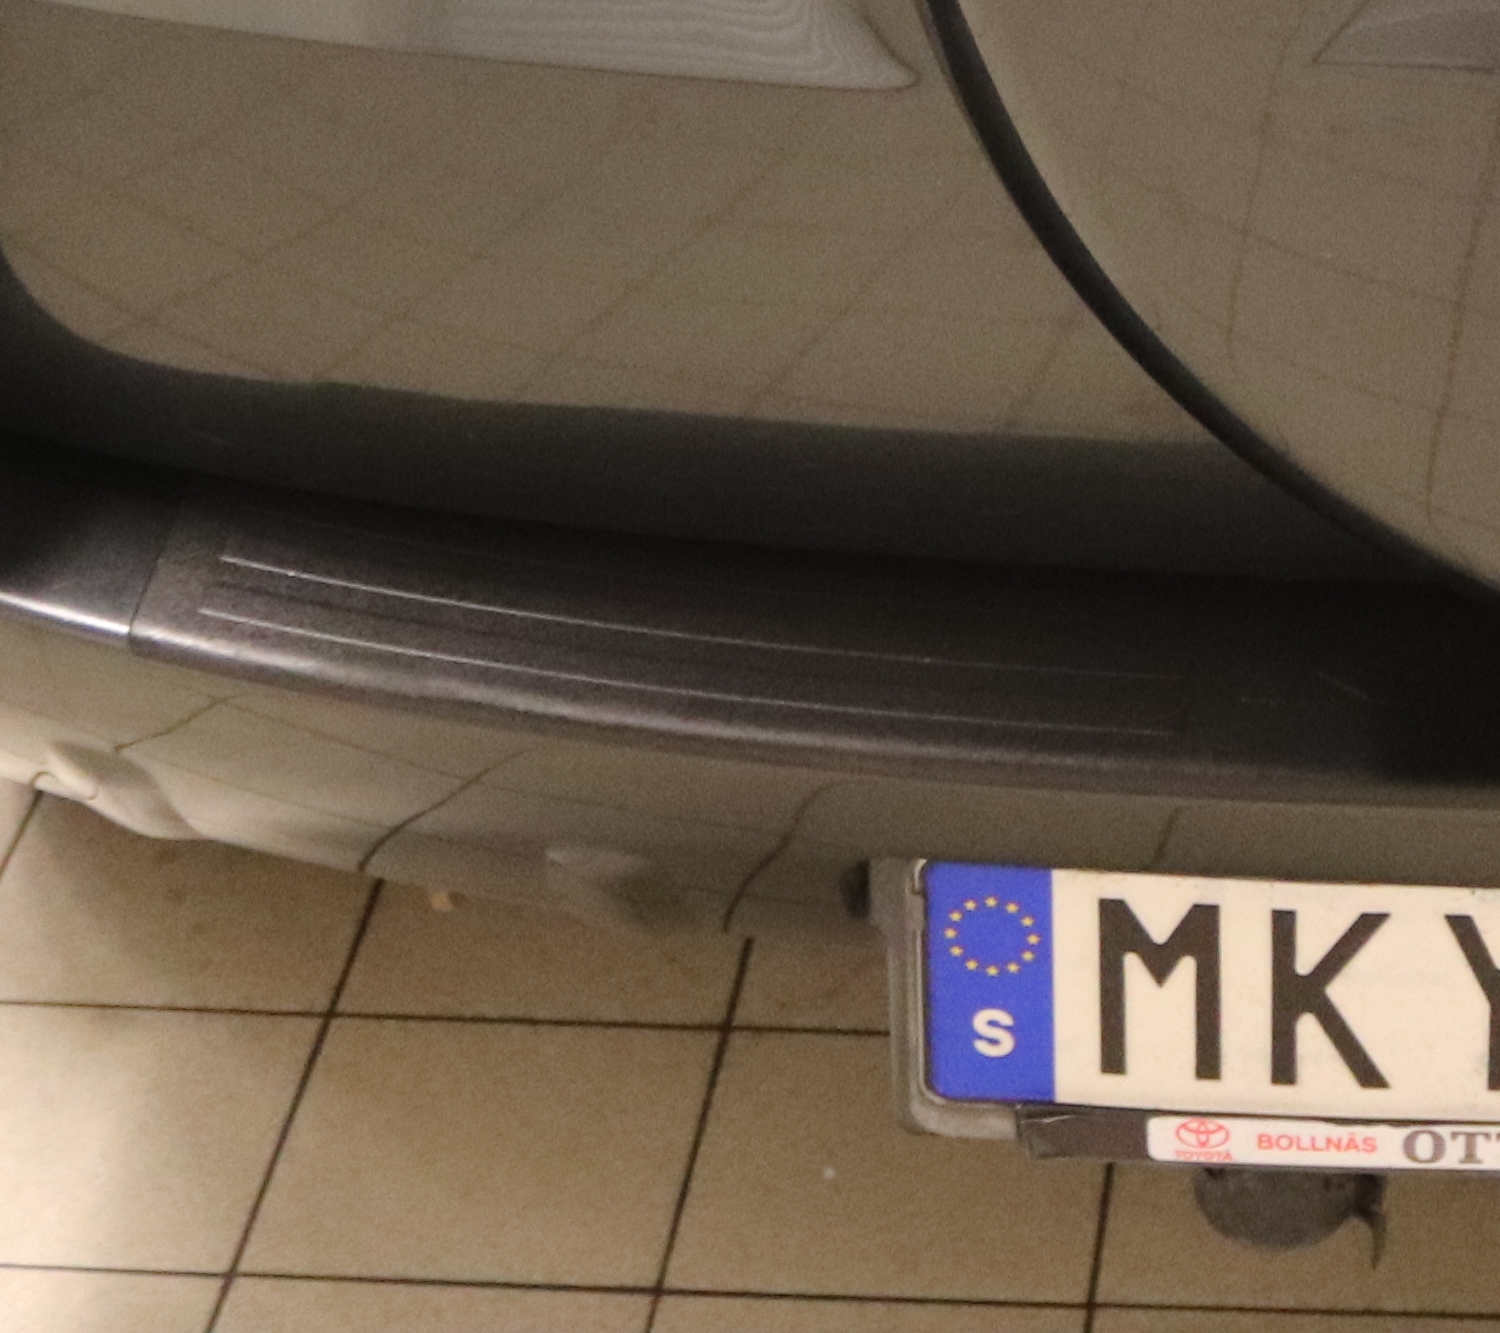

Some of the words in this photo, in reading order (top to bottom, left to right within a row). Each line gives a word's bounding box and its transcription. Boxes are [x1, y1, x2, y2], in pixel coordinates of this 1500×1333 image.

[971, 1007, 1016, 1059] S
[1257, 1130, 1377, 1153] BOLLNÄS
[1175, 1150, 1233, 1162] TOYOTA
